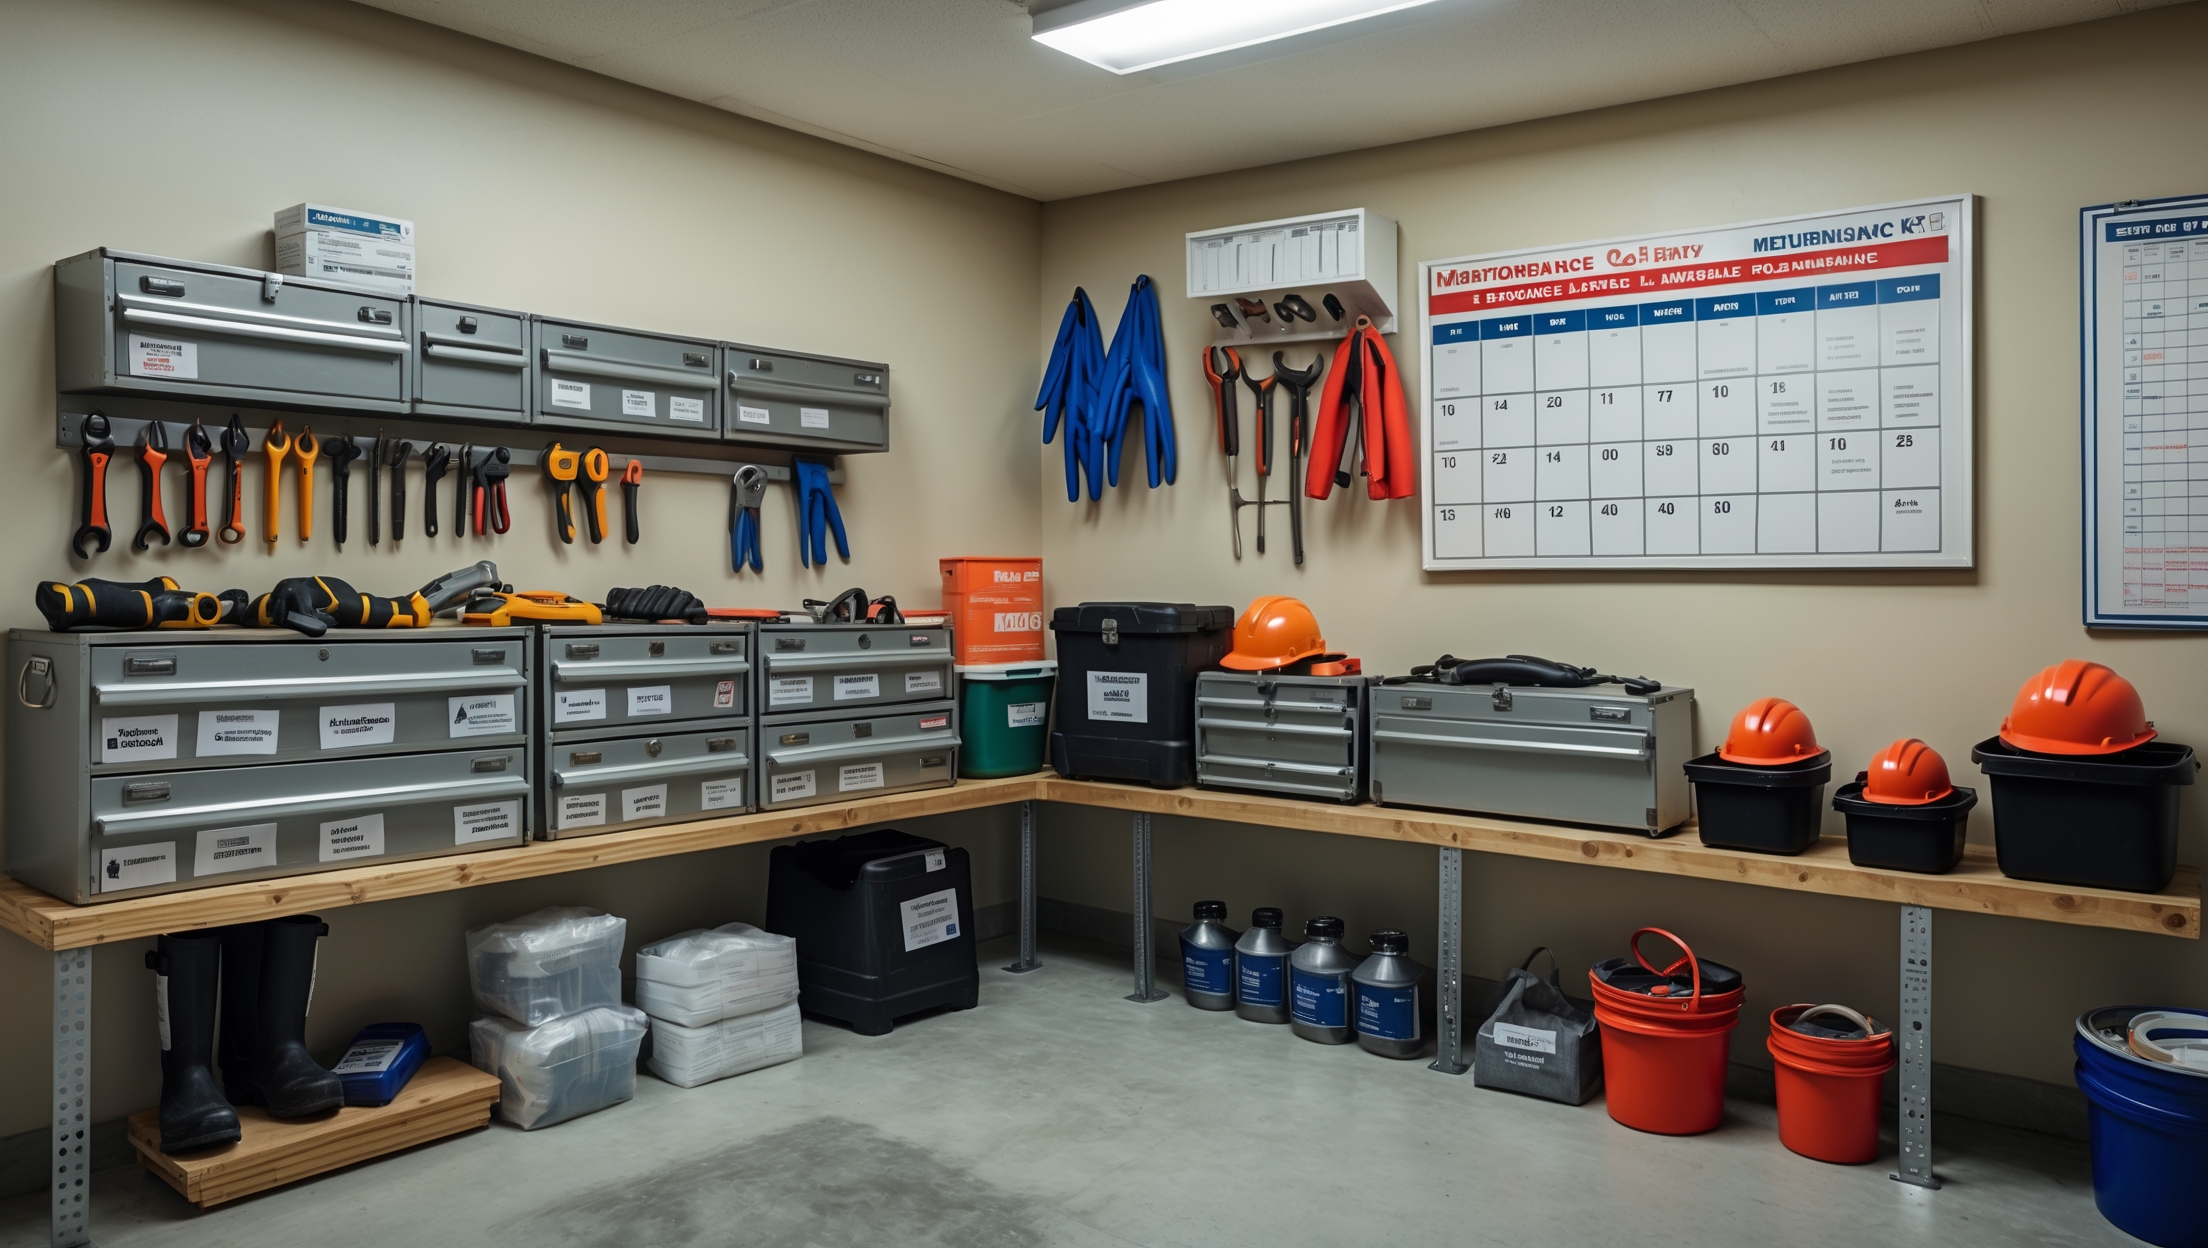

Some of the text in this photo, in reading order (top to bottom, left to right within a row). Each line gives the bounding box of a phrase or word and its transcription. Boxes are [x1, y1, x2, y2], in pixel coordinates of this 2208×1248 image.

[1494, 399, 1508, 411] 14
[1546, 396, 1563, 409] 20
[1600, 392, 1613, 405] 11
[1657, 389, 1673, 403] 77
[1712, 384, 1729, 399] 10
[1546, 450, 1561, 464] 14
[1829, 437, 1847, 451] 10
[1548, 505, 1564, 518] 12
